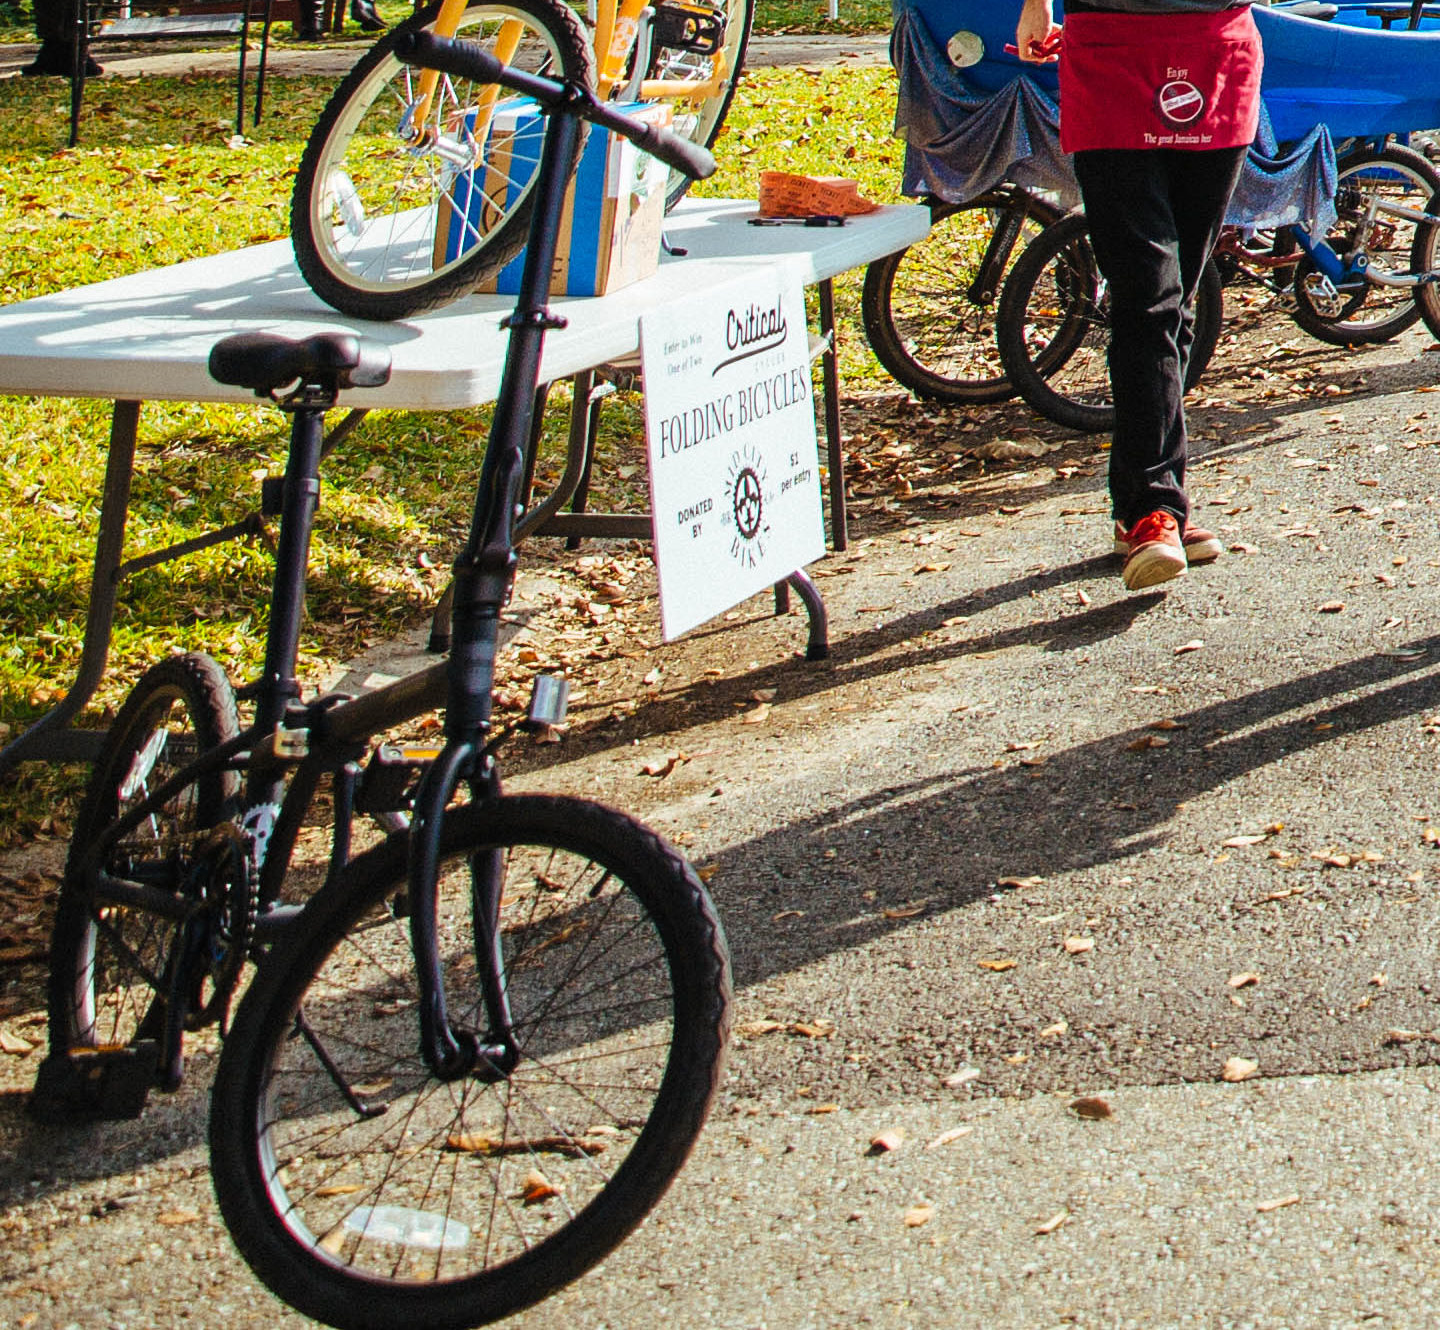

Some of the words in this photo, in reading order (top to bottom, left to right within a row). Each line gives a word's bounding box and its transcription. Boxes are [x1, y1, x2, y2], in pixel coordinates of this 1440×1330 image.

[1166, 66, 1189, 81] Enjoy
[1143, 132, 1158, 144] The
[725, 293, 788, 352] Critical
[663, 339, 681, 357] Enter
[660, 394, 734, 459] FOLDING
[738, 365, 807, 427] BICYCLES
[789, 451, 800, 467] $1
[781, 478, 793, 496] per
[793, 467, 812, 487] entry
[677, 498, 714, 525] DONATED
[692, 523, 704, 539] BY
